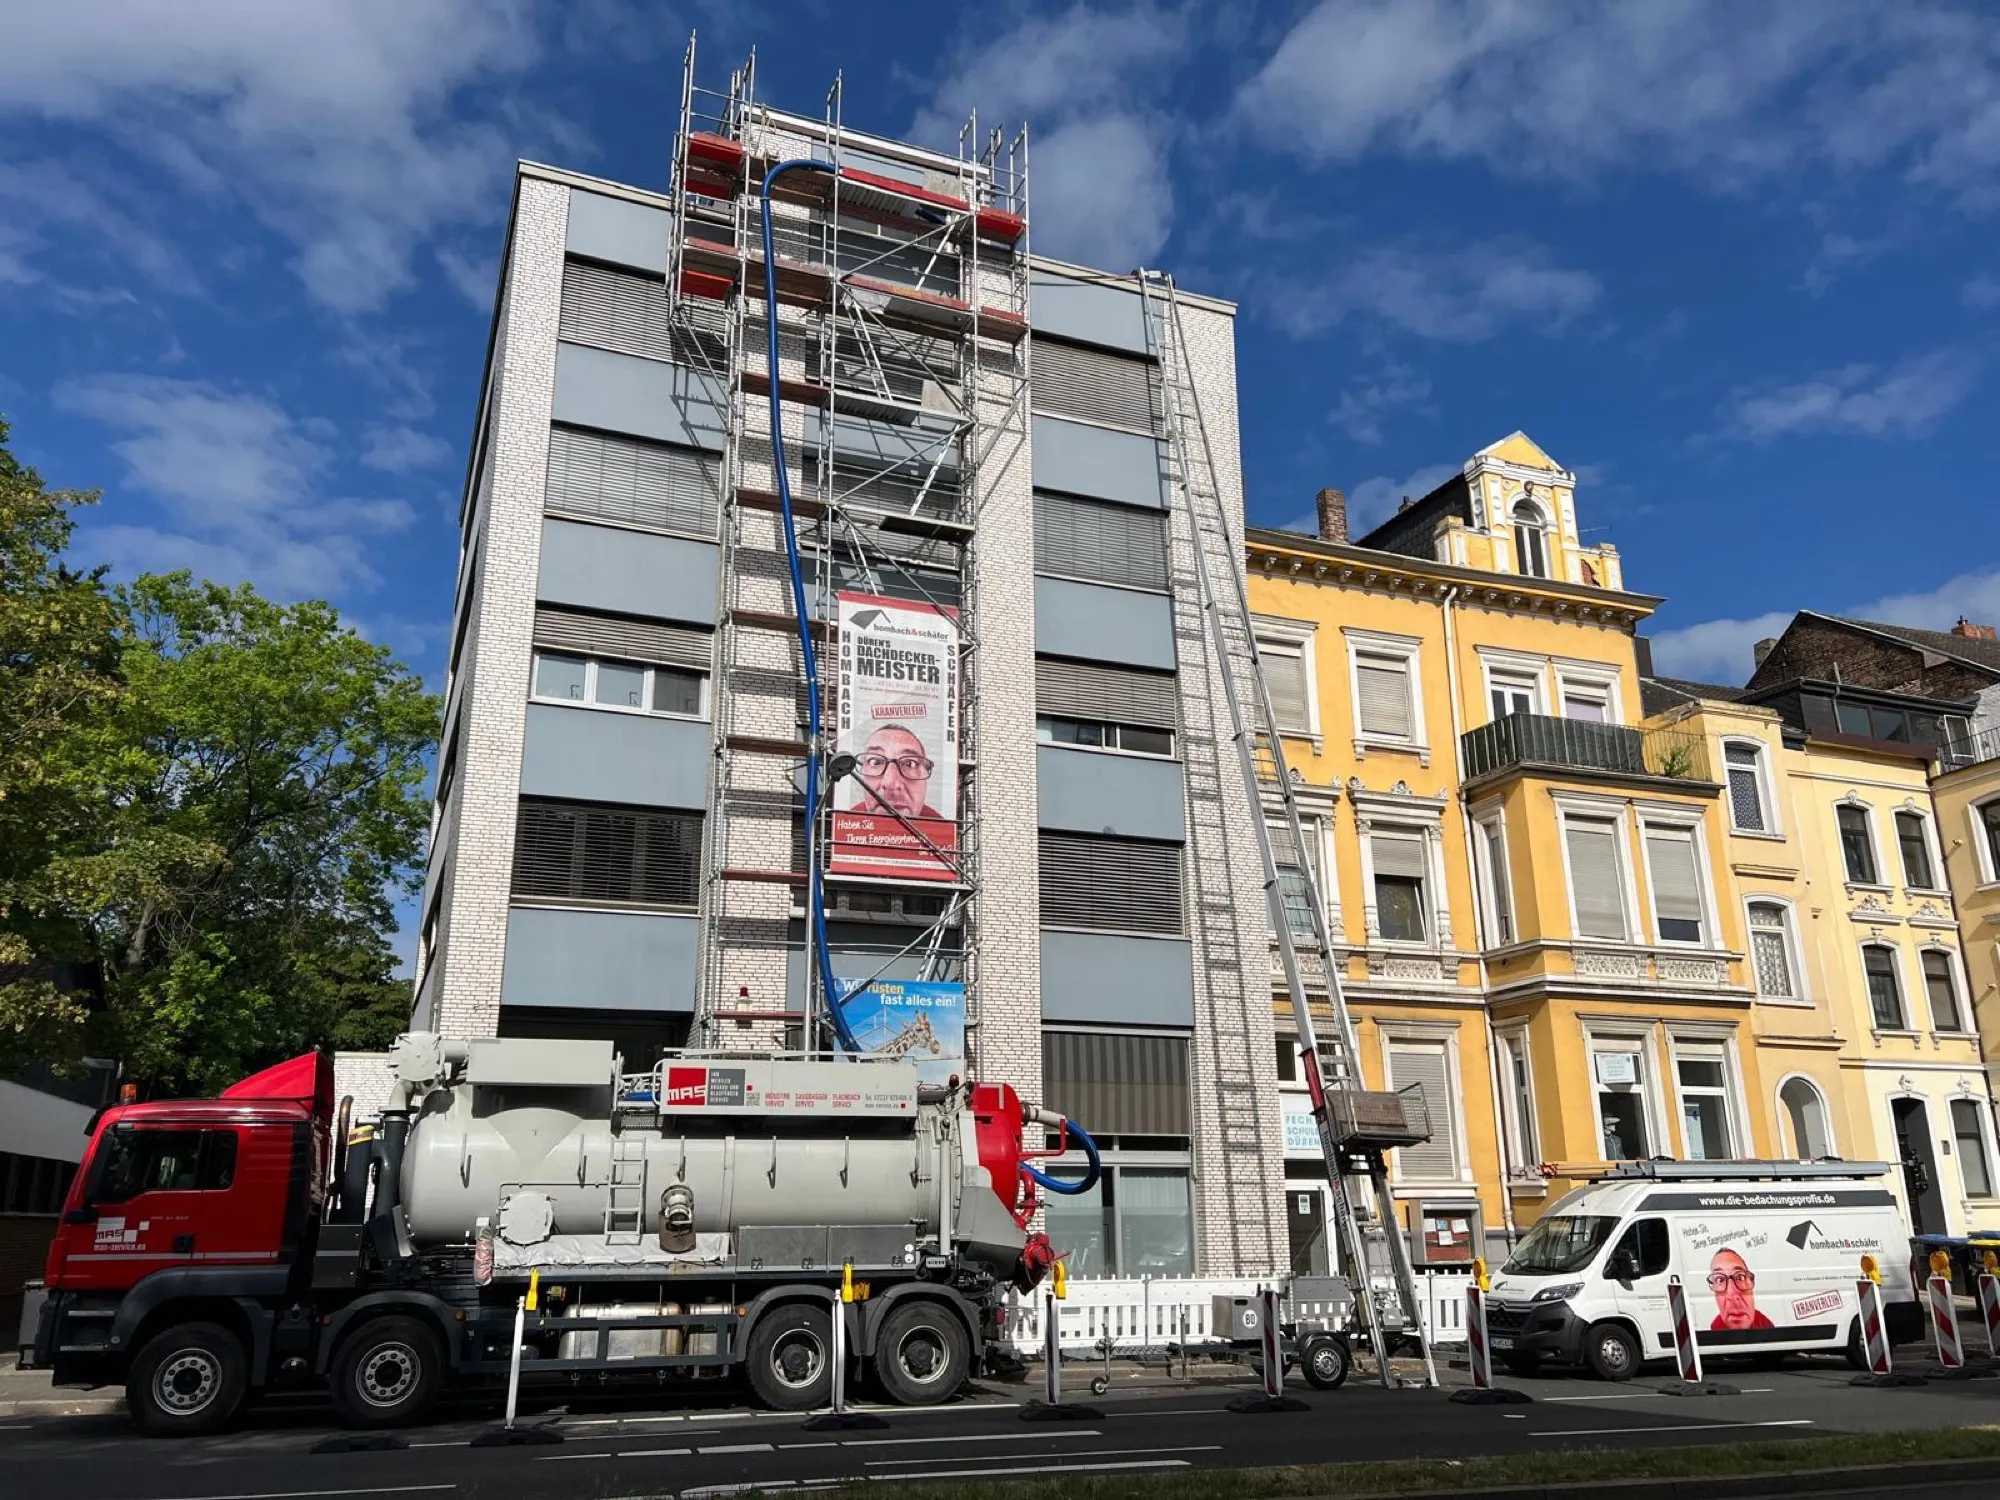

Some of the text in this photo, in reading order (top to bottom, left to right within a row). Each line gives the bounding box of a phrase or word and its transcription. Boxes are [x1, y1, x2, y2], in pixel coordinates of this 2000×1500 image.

[857, 645, 940, 664] DACHDECKER-
[857, 657, 940, 684] MEISTER
[841, 631, 852, 729] HOMBACH
[874, 705, 925, 717] KRANVERLEIH
[866, 982, 905, 994] rüsten
[880, 994, 956, 1007] fast alles ein!
[668, 1084, 706, 1100] MAS
[1285, 1114, 1315, 1124] FECH
[1699, 1194, 1836, 1206] www.die-bedachungsprofis.de
[1795, 1293, 1841, 1314] KRANVERLEIH
